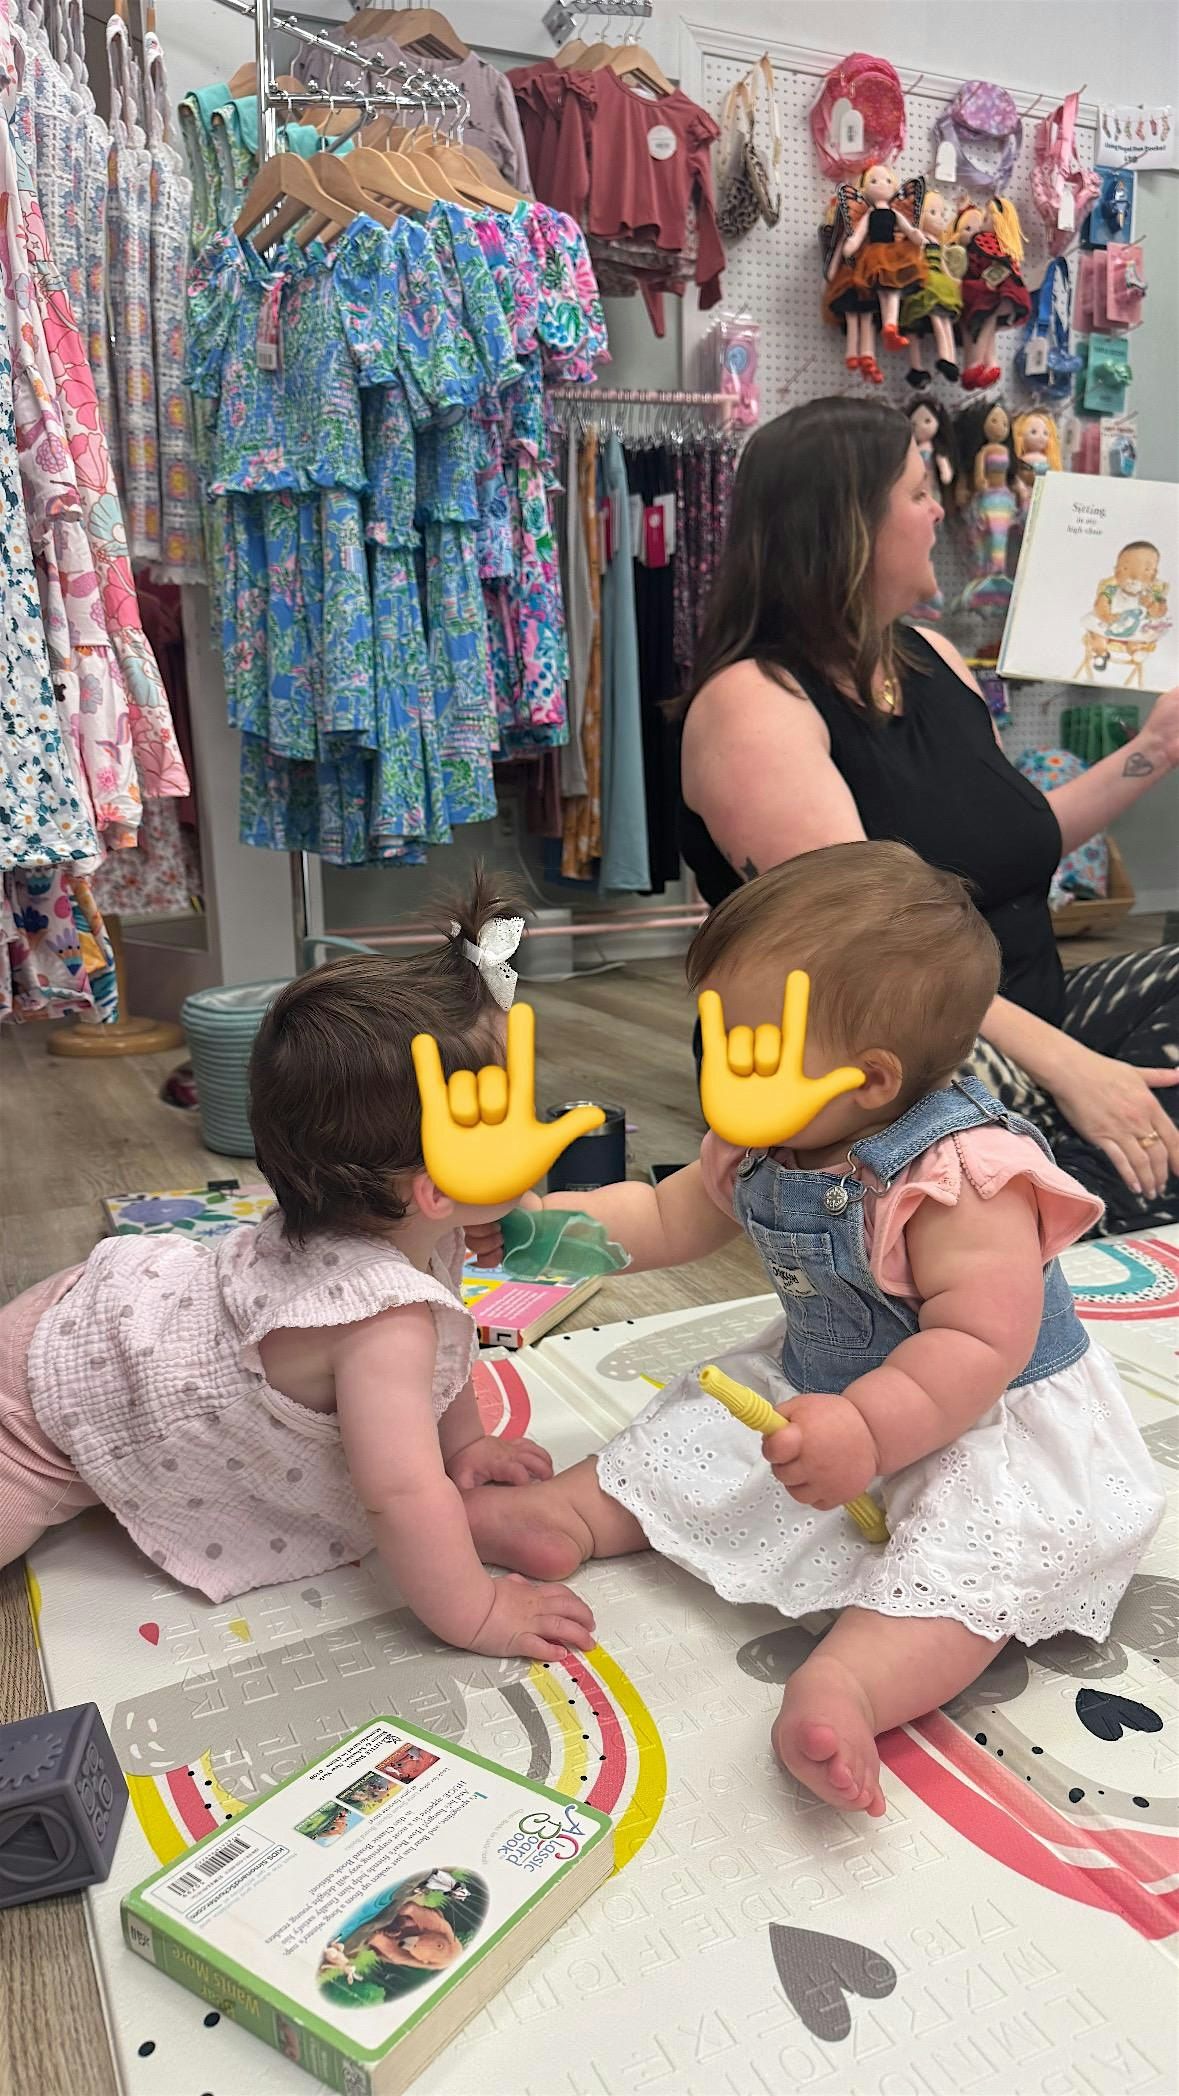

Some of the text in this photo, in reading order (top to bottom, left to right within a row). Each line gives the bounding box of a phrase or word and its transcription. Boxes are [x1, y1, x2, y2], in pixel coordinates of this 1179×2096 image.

[1072, 501, 1106, 518] Sitting
[441, 1779, 467, 1798] HUGE
[416, 1796, 445, 1817] appetite
[436, 1798, 473, 1826] springtime,
[391, 1816, 407, 1827] this
[426, 1825, 442, 1836] and
[370, 1825, 396, 1844] Classic
[391, 1825, 410, 1839] most
[412, 1834, 431, 1848] Bear
[523, 1804, 587, 1873] A Classic
[351, 1843, 374, 1860] Board
[358, 1837, 395, 1865] surprising
[388, 1854, 406, 1867] just
[402, 1846, 417, 1857] has
[279, 1788, 470, 1946] And he's hungry! How Bear's friends help him finally satisfy his
[333, 1858, 355, 1875] Book
[345, 1862, 364, 1875] way
[370, 1865, 394, 1884] woken
[186, 1846, 285, 1920] KIDS.SimonandSchuster.com
[307, 1873, 337, 1896] edition!
[334, 1874, 352, 1886] will
[359, 1881, 373, 1891] up
[309, 1883, 339, 1906] delight
[345, 1890, 365, 1905] from
[287, 1903, 314, 1923] young
[322, 1907, 344, 1923] long
[263, 1922, 293, 1945] readers
[297, 1921, 328, 1945] winter's
[171, 1944, 262, 2018] Wants More
